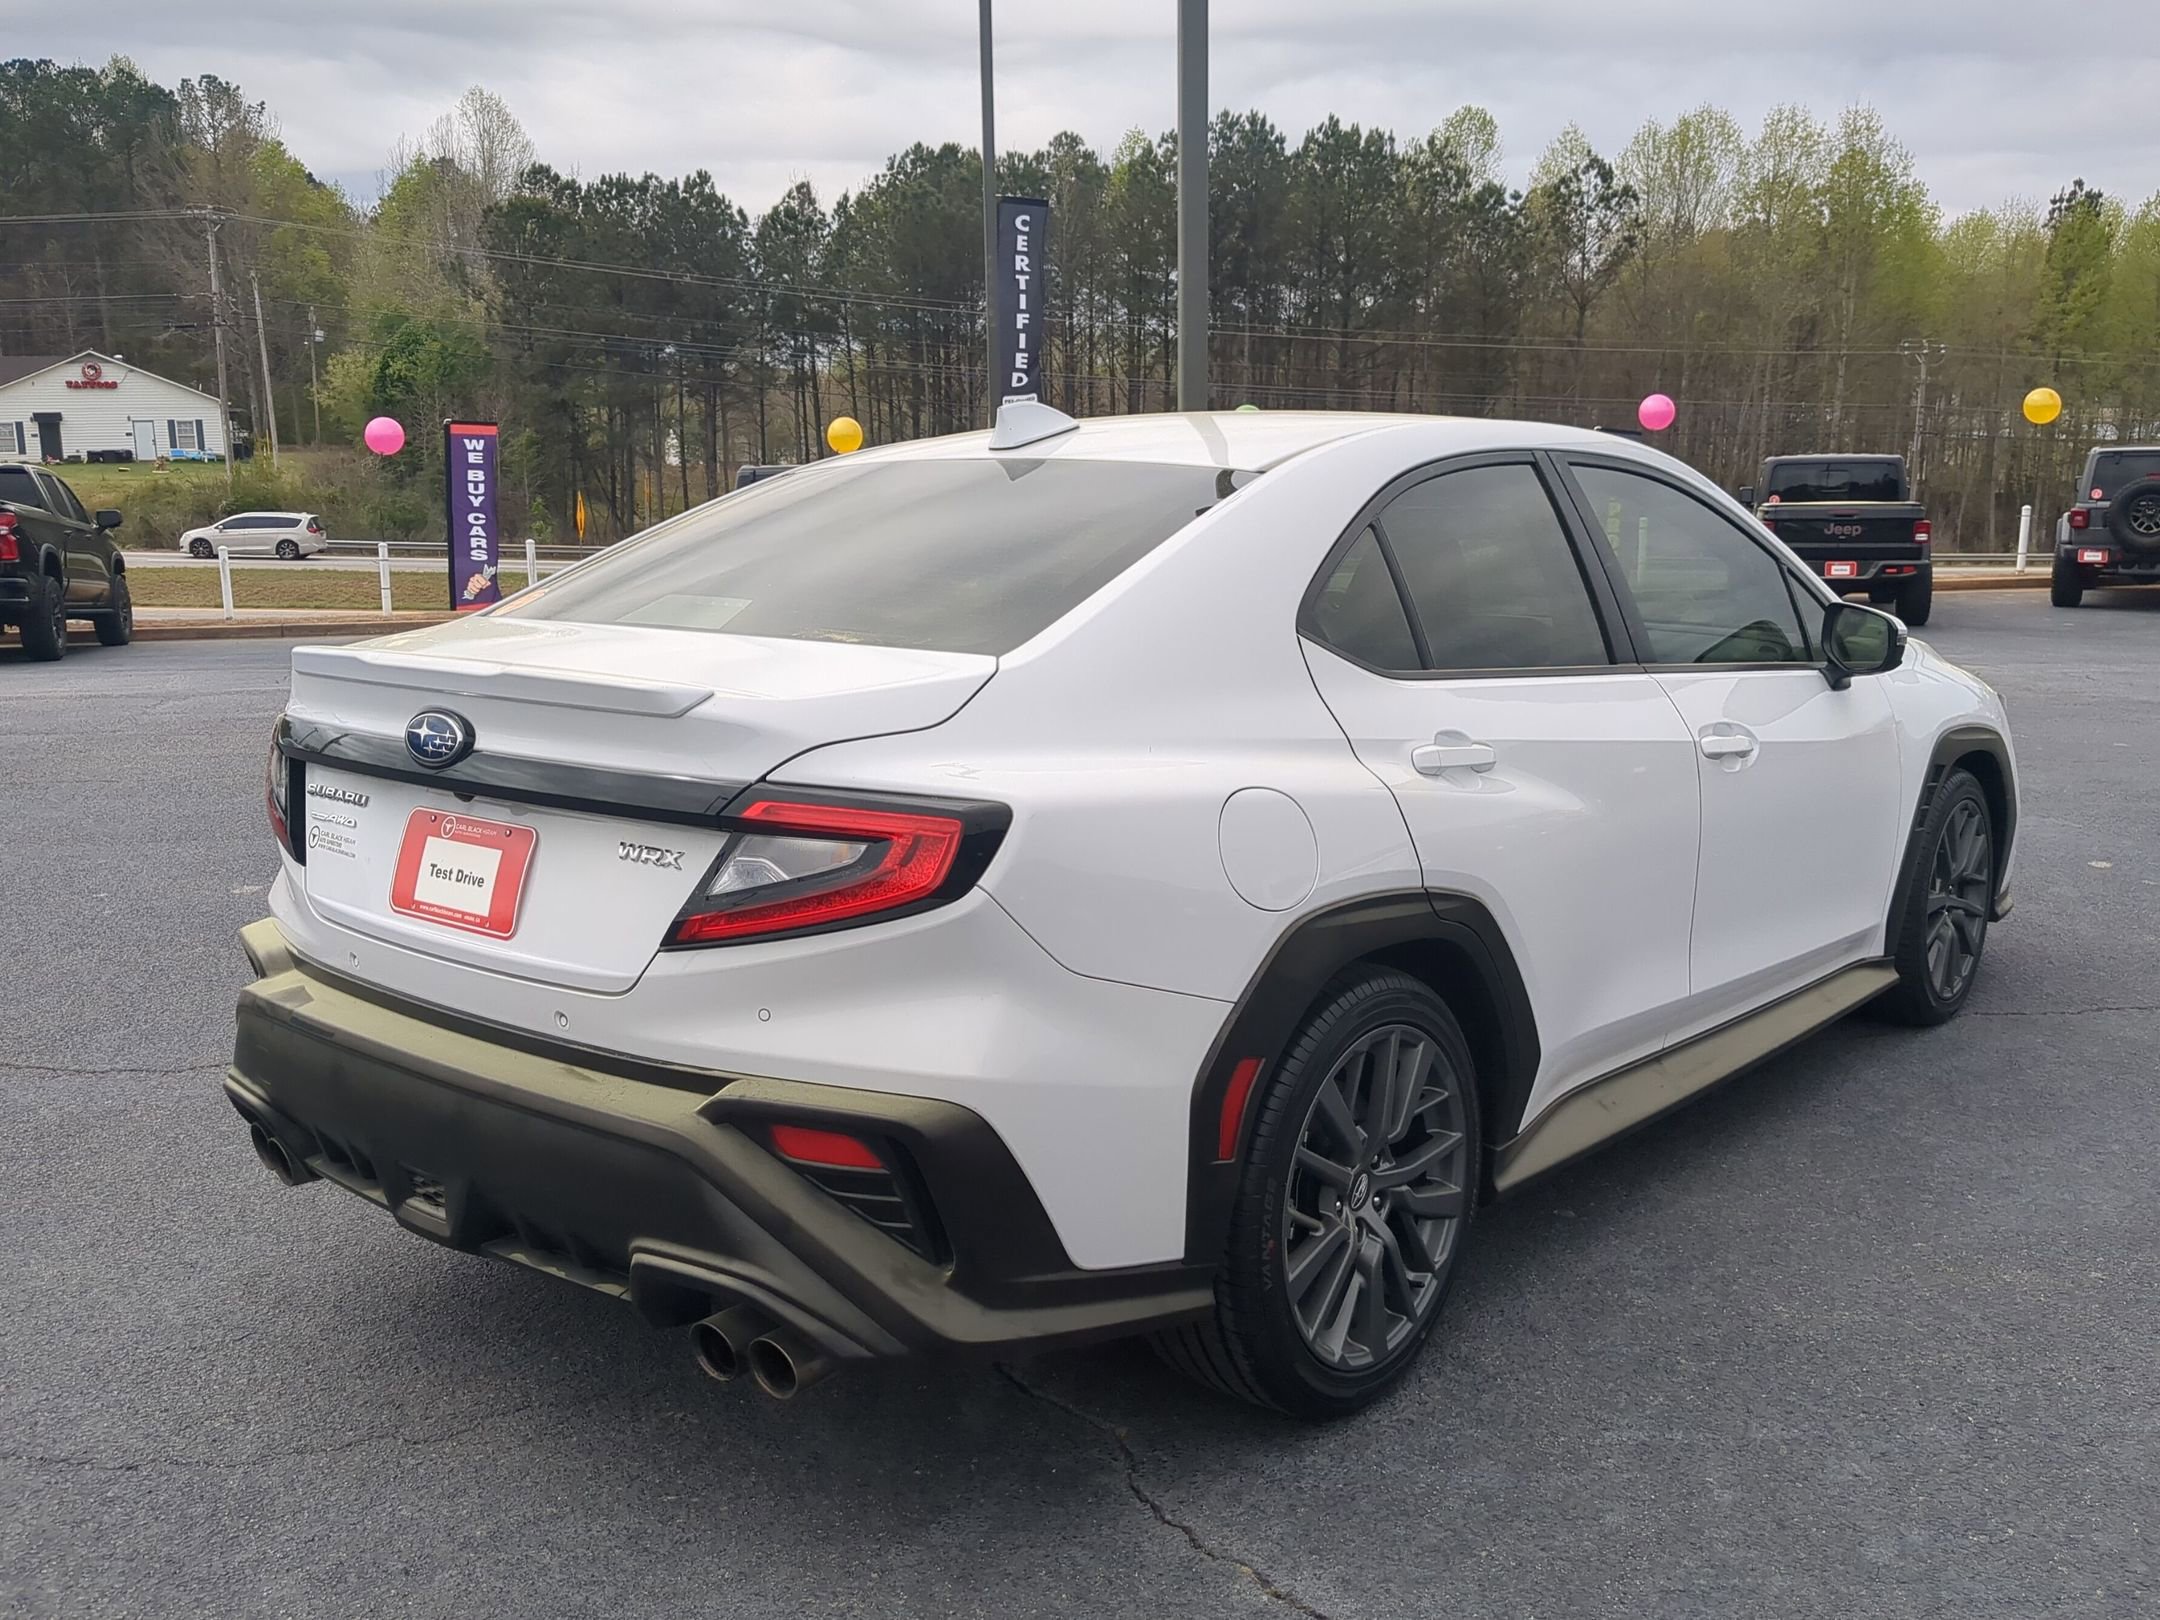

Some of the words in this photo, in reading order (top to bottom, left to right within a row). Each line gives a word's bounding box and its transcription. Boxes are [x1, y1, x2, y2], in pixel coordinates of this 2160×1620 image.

[1011, 215, 1031, 388] CERTIFIED
[463, 439, 485, 464] WE
[467, 470, 486, 507] BUY
[467, 513, 489, 561] CARS
[1823, 523, 1862, 537] Jeep
[307, 783, 369, 808] SUBARU
[325, 814, 357, 828] AWD
[467, 825, 482, 834] BLACK
[618, 841, 686, 871] WRX
[430, 863, 453, 881] Test
[455, 868, 485, 888] Drive
